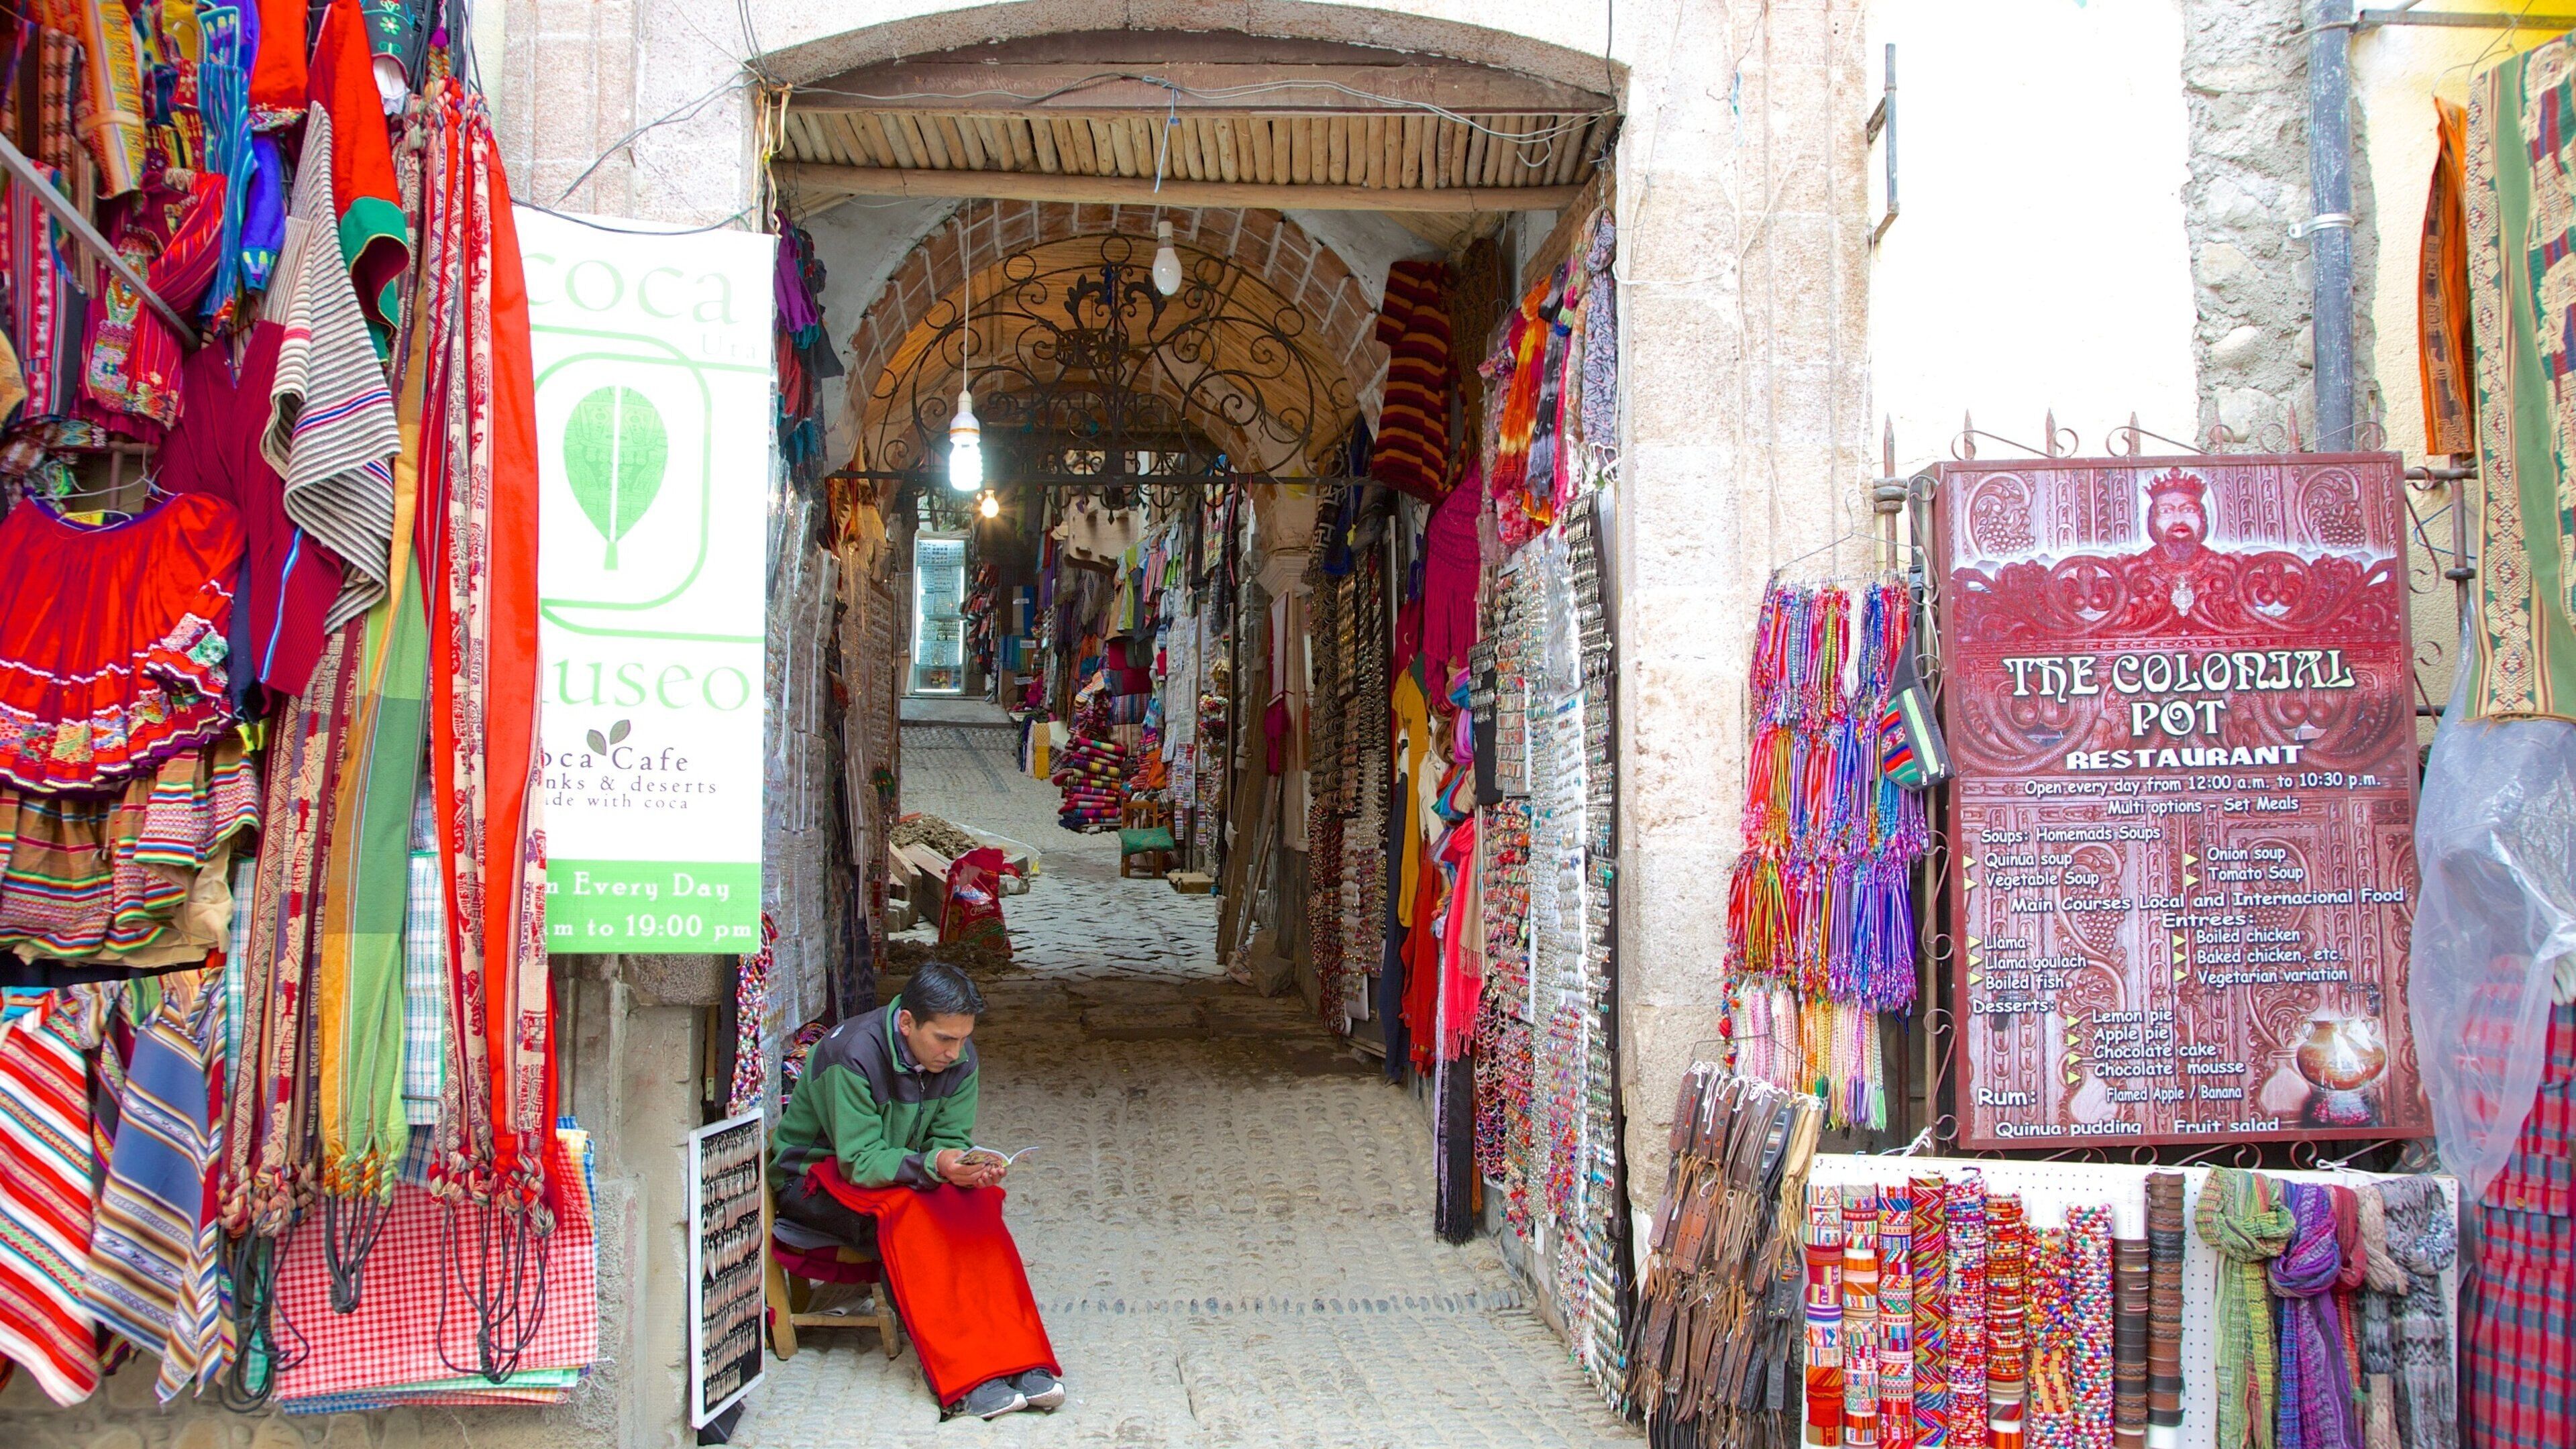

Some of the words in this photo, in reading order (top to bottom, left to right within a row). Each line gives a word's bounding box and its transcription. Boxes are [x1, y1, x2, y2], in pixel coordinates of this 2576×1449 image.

[543, 656, 750, 711] useo
[2002, 656, 2099, 703] THE
[2112, 650, 2355, 693] COLONIAL
[2131, 700, 2226, 736] POT
[612, 747, 688, 771] Cafe
[2067, 745, 2304, 769] RESTAURANT
[600, 776, 614, 791] &
[631, 775, 716, 793] deserts
[2025, 780, 2061, 798] Open
[2068, 782, 2108, 796] every
[2114, 777, 2140, 795] day
[2148, 777, 2181, 791] from
[2189, 775, 2231, 790] 12:00
[2237, 777, 2269, 789] a.m.
[2277, 775, 2293, 787] to
[2300, 772, 2343, 786] 10:30
[2349, 775, 2381, 789] p.m.
[588, 794, 631, 807] with
[644, 799, 688, 808] coca
[2108, 800, 2144, 814] Multi
[2151, 801, 2202, 815] options
[2224, 798, 2250, 810] Set
[2256, 795, 2299, 810] Meals
[1981, 829, 2028, 845] Soups:
[2036, 826, 2112, 842] Homemads
[2118, 826, 2160, 841] Soups
[1984, 853, 2034, 869] Quinua
[2041, 853, 2073, 868] soup
[2207, 847, 2248, 861] Onion
[2254, 848, 2286, 862] soup
[1986, 872, 2058, 890] Vegetable
[2065, 872, 2099, 888] Soup
[2208, 867, 2261, 881] Tomato
[2268, 866, 2304, 882] Soup
[574, 871, 658, 901] Every
[673, 873, 729, 902] Day
[2011, 898, 2053, 912] Main
[2061, 897, 2131, 910] Courses
[2139, 894, 2184, 909] Local
[2193, 892, 2224, 908] and
[2233, 889, 2353, 906] Internacional
[2361, 887, 2404, 903] Food
[587, 919, 614, 936] to
[626, 914, 703, 937] 19:00
[714, 925, 751, 941] pm
[2161, 912, 2255, 928] Entrees:
[1984, 935, 2026, 950] Llama
[2196, 928, 2240, 943] Boiled
[2247, 928, 2300, 943] chicken
[1985, 955, 2026, 969] Llama
[2033, 953, 2086, 972] goulach
[2197, 949, 2241, 963] Baked
[2247, 948, 2306, 963] chicken,
[2314, 948, 2343, 960] etc.
[1986, 975, 2029, 989] Boiled
[2036, 974, 2064, 988] fish
[2198, 968, 2277, 987] Vegetarian
[2284, 967, 2347, 982] variation
[1972, 999, 2055, 1014] Desserts:
[2092, 1009, 2143, 1023] Lemon
[2150, 1008, 2174, 1024] pie
[2094, 1026, 2137, 1044] Apple
[2146, 1026, 2168, 1042] pie
[2094, 1044, 2171, 1059] Chocolate
[2179, 1042, 2216, 1057] cake
[2094, 1061, 2173, 1077] Chocolate
[2188, 1062, 2245, 1074] mousse
[1978, 1087, 2037, 1106] Rum:
[2106, 1085, 2147, 1102] Flamed
[2153, 1087, 2184, 1103] Apple
[2189, 1085, 2196, 1099] /
[2201, 1085, 2242, 1099] Banana
[1996, 1122, 2061, 1138] Quinua
[2071, 1120, 2142, 1136] pudding
[2174, 1119, 2222, 1134] Fruit
[2230, 1118, 2279, 1132] salad
